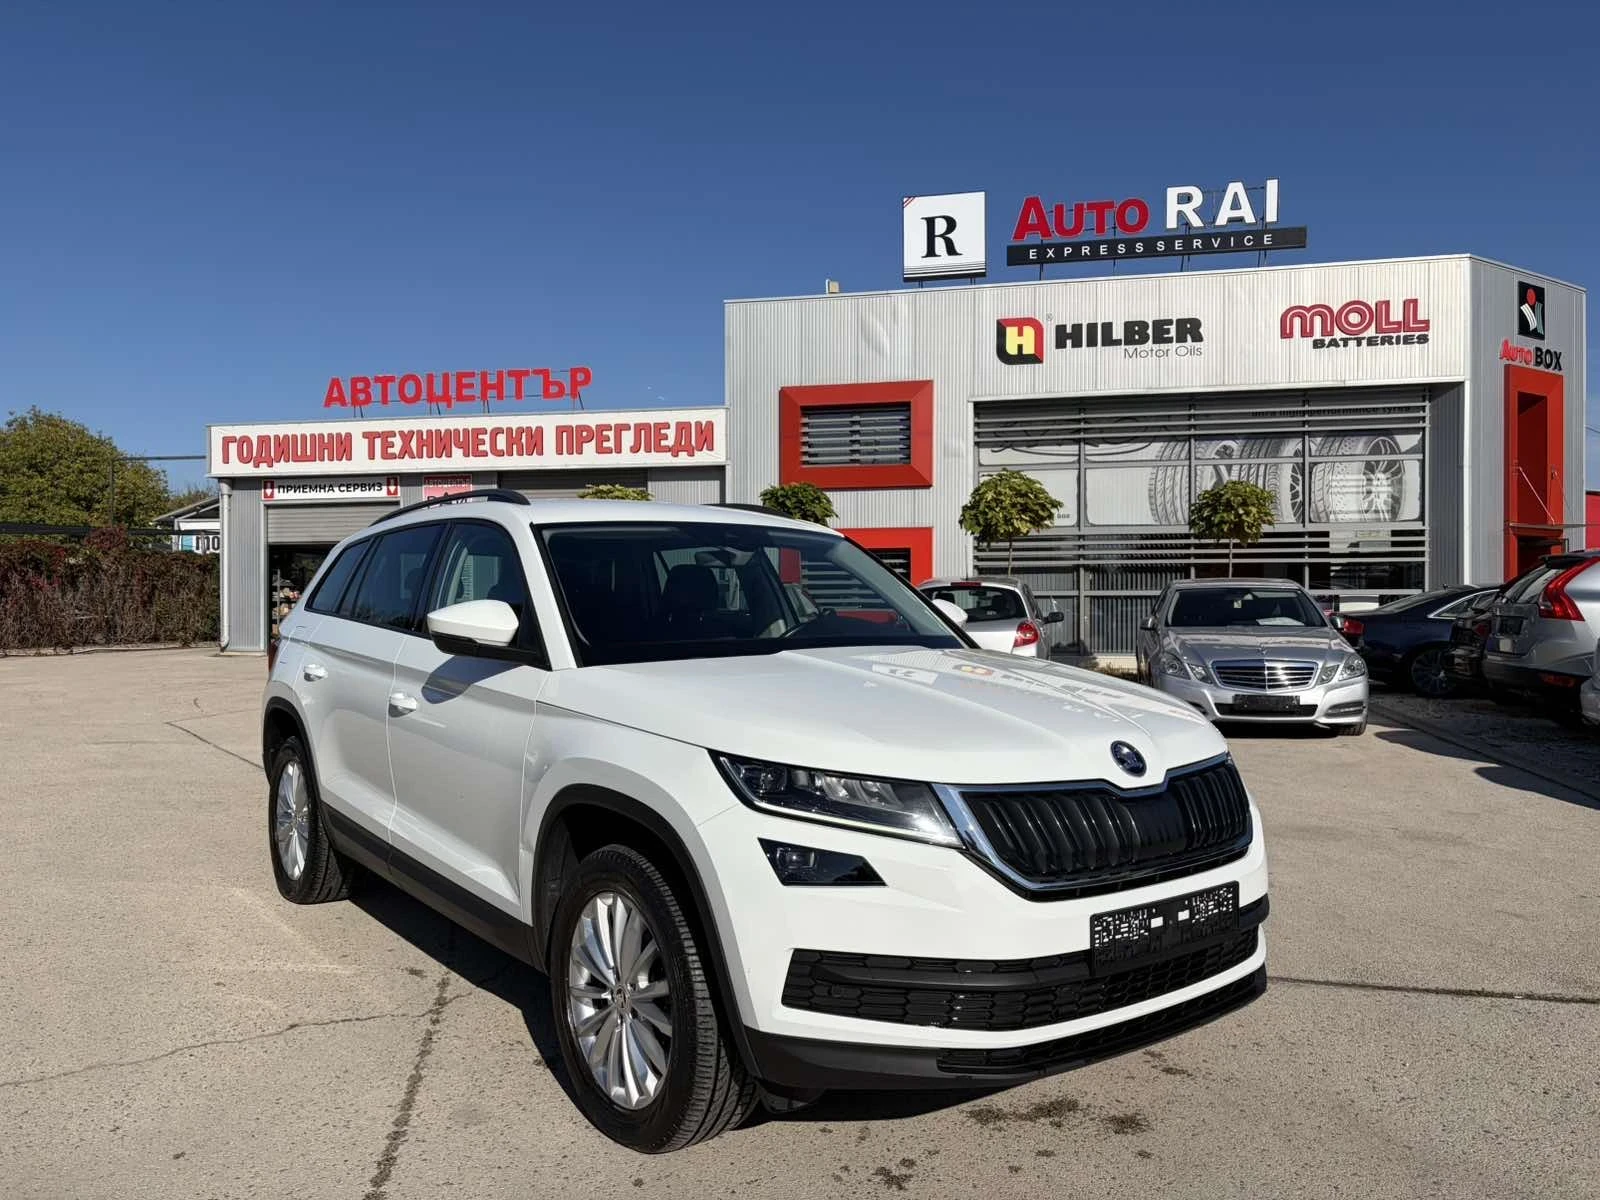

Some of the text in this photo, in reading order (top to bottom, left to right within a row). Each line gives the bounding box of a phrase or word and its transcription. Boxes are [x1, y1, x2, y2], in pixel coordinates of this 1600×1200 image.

[1166, 178, 1279, 230] RAI
[920, 214, 964, 259] R
[1029, 233, 1273, 260] EXPRESS SERVICE
[1005, 325, 1036, 356] H
[1055, 317, 1204, 350] HILBER
[1312, 333, 1430, 350] BATTERIES
[1123, 344, 1203, 360] Motor Oils
[1534, 346, 1562, 371] BOX
[322, 366, 593, 410] АВТОЦЕНТЪР
[221, 419, 716, 469] ГОДИШНИ ТЕХНИЧЕСКИ ПРЕГЛЕДИ
[277, 481, 384, 494] ПРИЕМНА СЕРВИЗ
